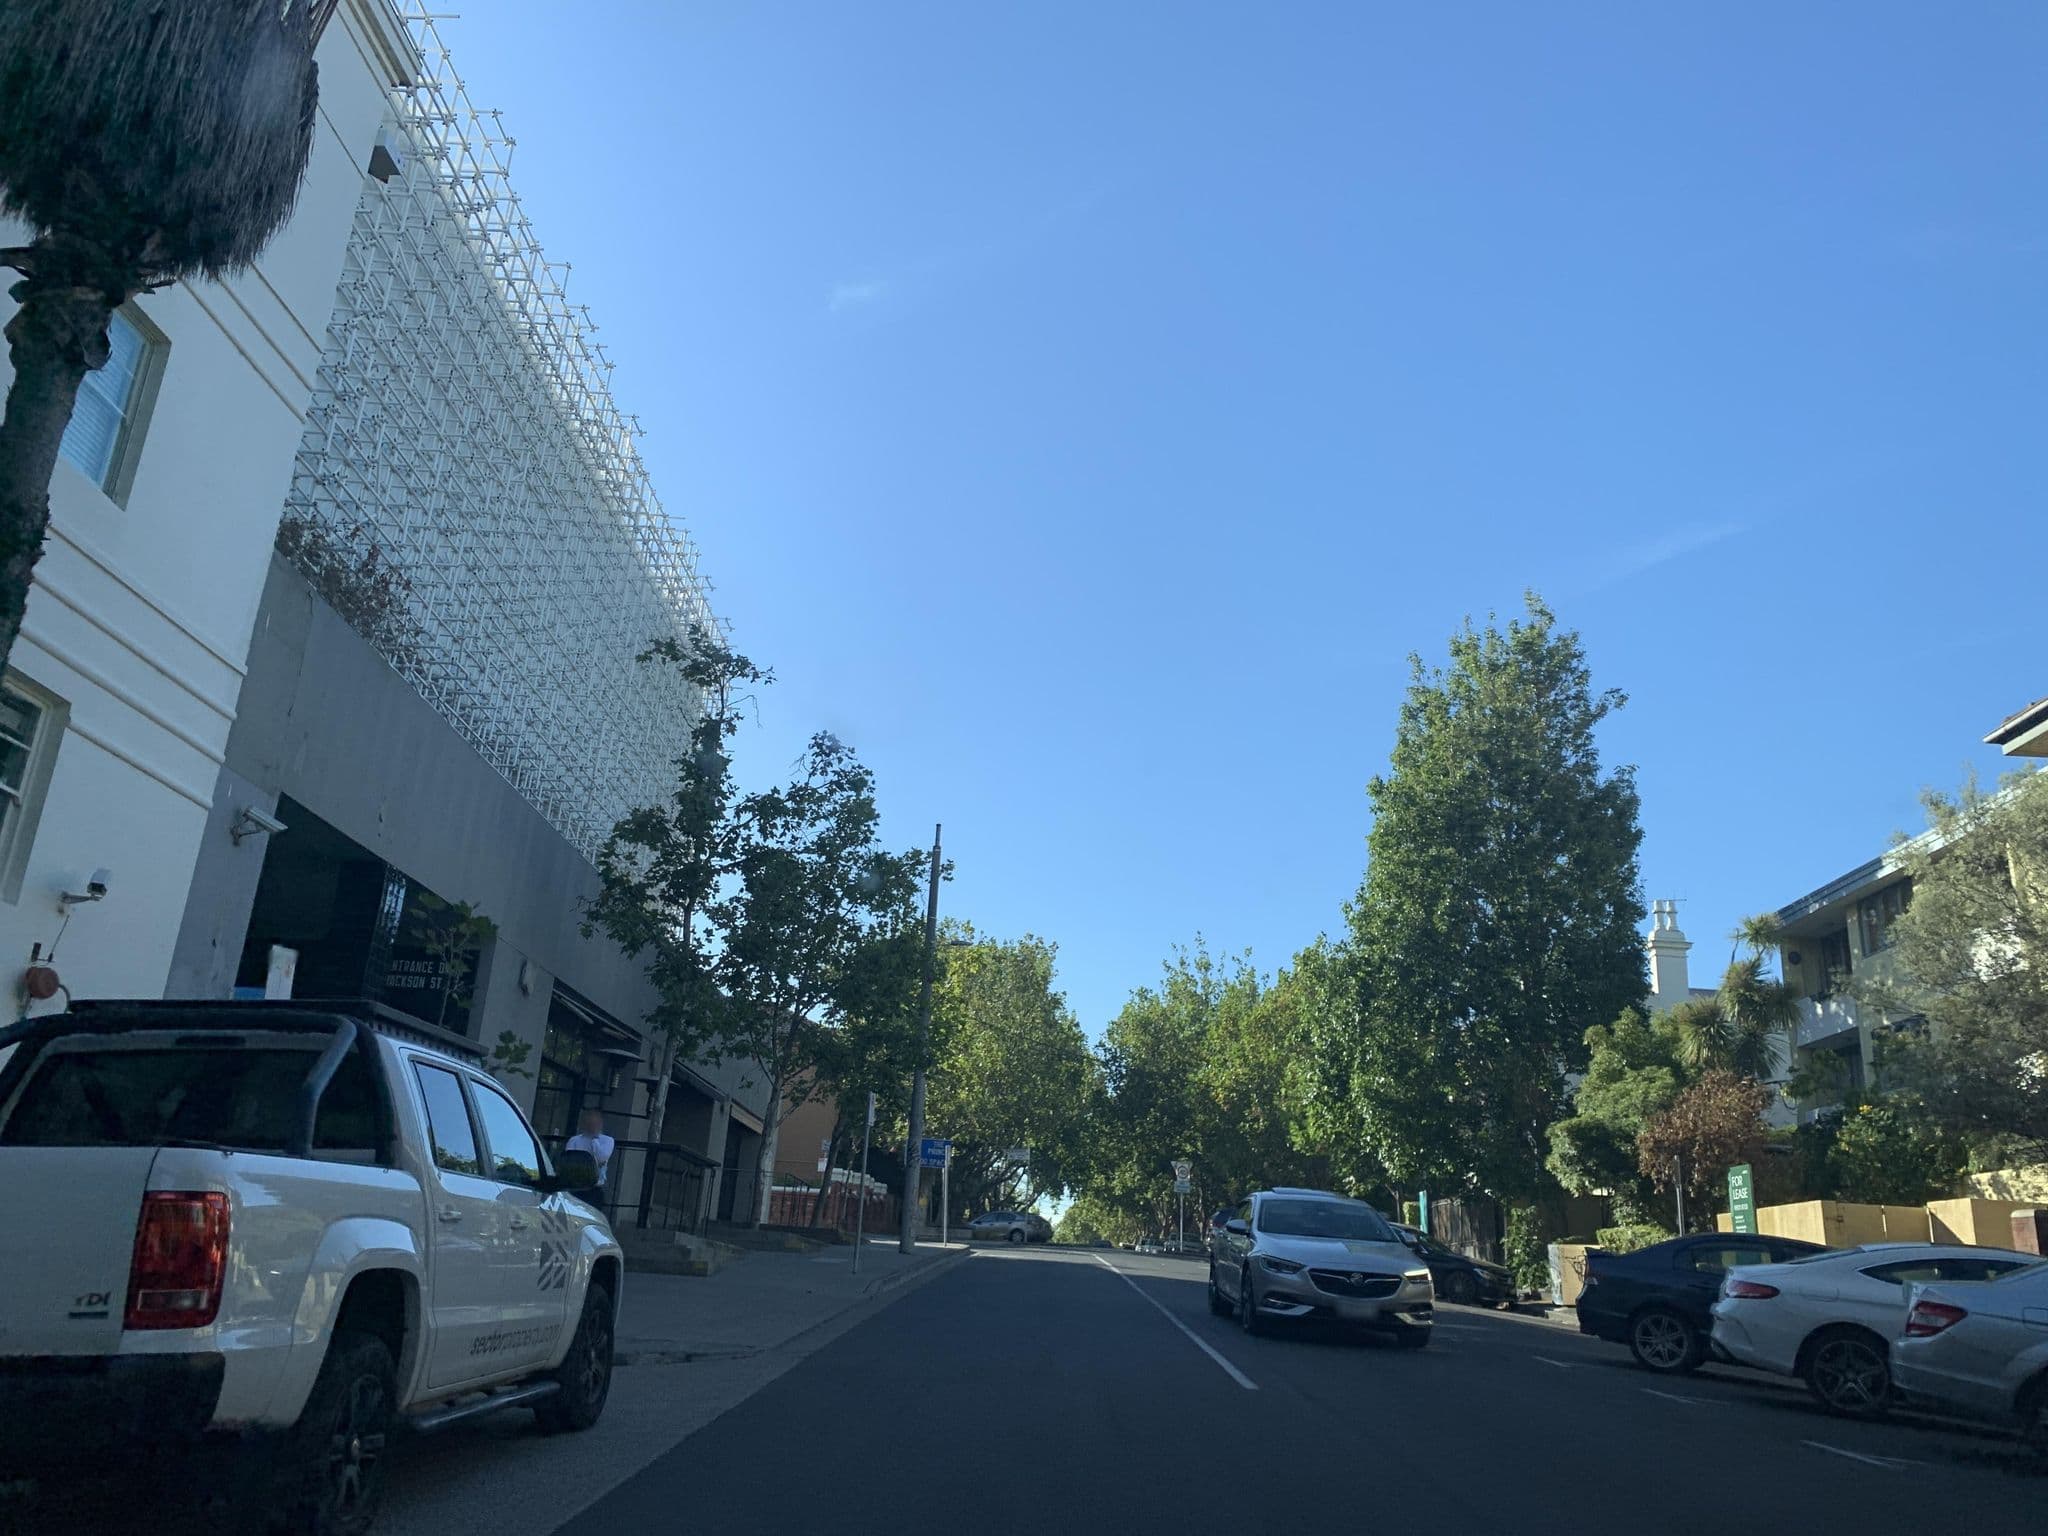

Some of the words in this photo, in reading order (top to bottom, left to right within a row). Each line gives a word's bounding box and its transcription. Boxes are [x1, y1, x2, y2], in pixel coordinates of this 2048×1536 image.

[389, 960, 434, 974] NTRANCE
[1731, 1175, 1743, 1188] FOR
[1732, 1187, 1749, 1200] LEASE
